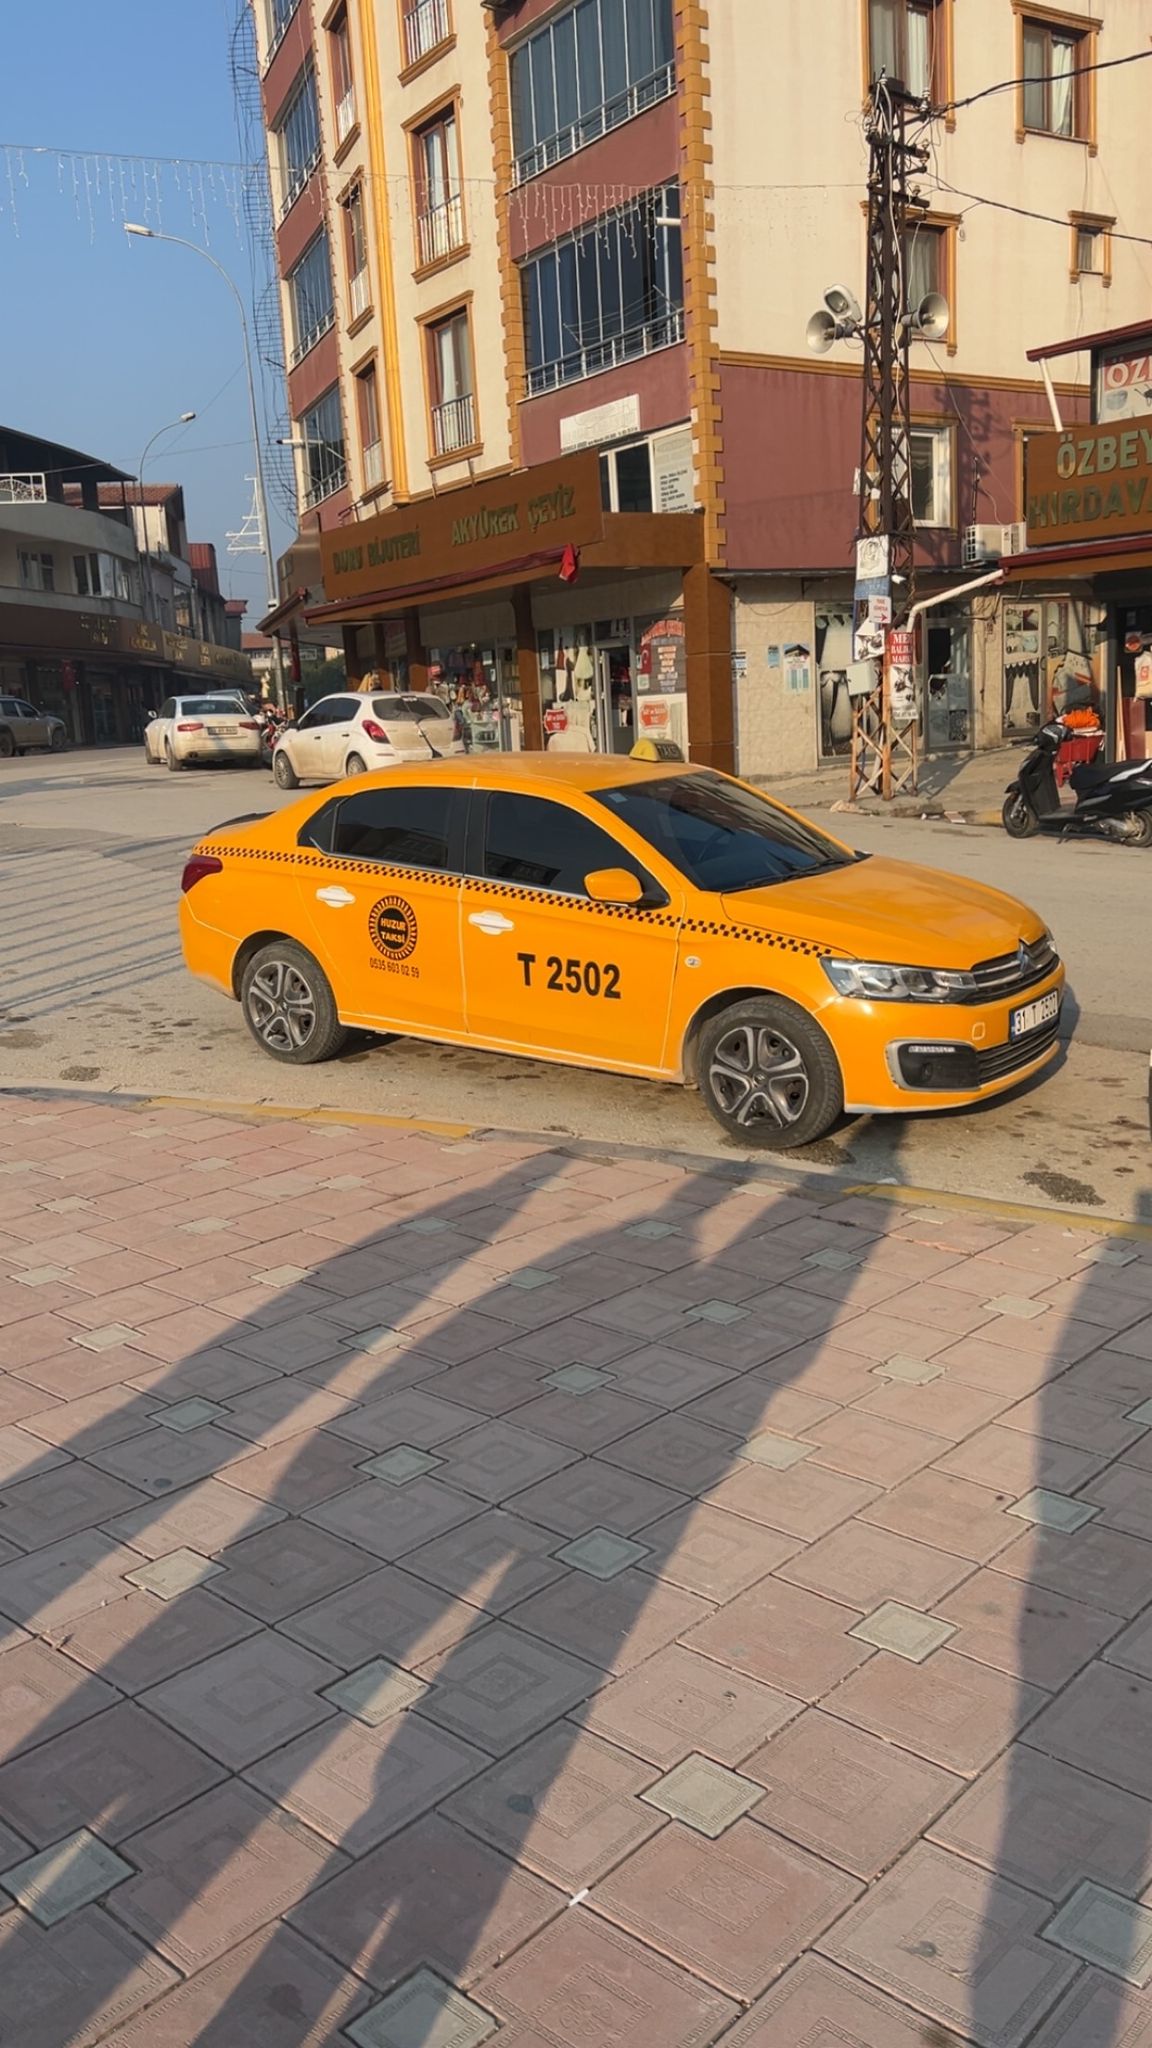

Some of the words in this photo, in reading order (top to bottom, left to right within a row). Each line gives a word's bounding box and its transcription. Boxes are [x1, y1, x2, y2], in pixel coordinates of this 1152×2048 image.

[1107, 355, 1152, 389] ÖZ
[451, 503, 520, 547] AKYÜREK
[527, 483, 577, 533] ÇEYİZ
[1029, 479, 1152, 529] HIRDAV
[380, 918, 406, 932] HUZUR
[380, 931, 406, 944] TAKSİ
[517, 952, 536, 987] T
[547, 955, 622, 1000] 2502
[1016, 1010, 1026, 1032] 31
